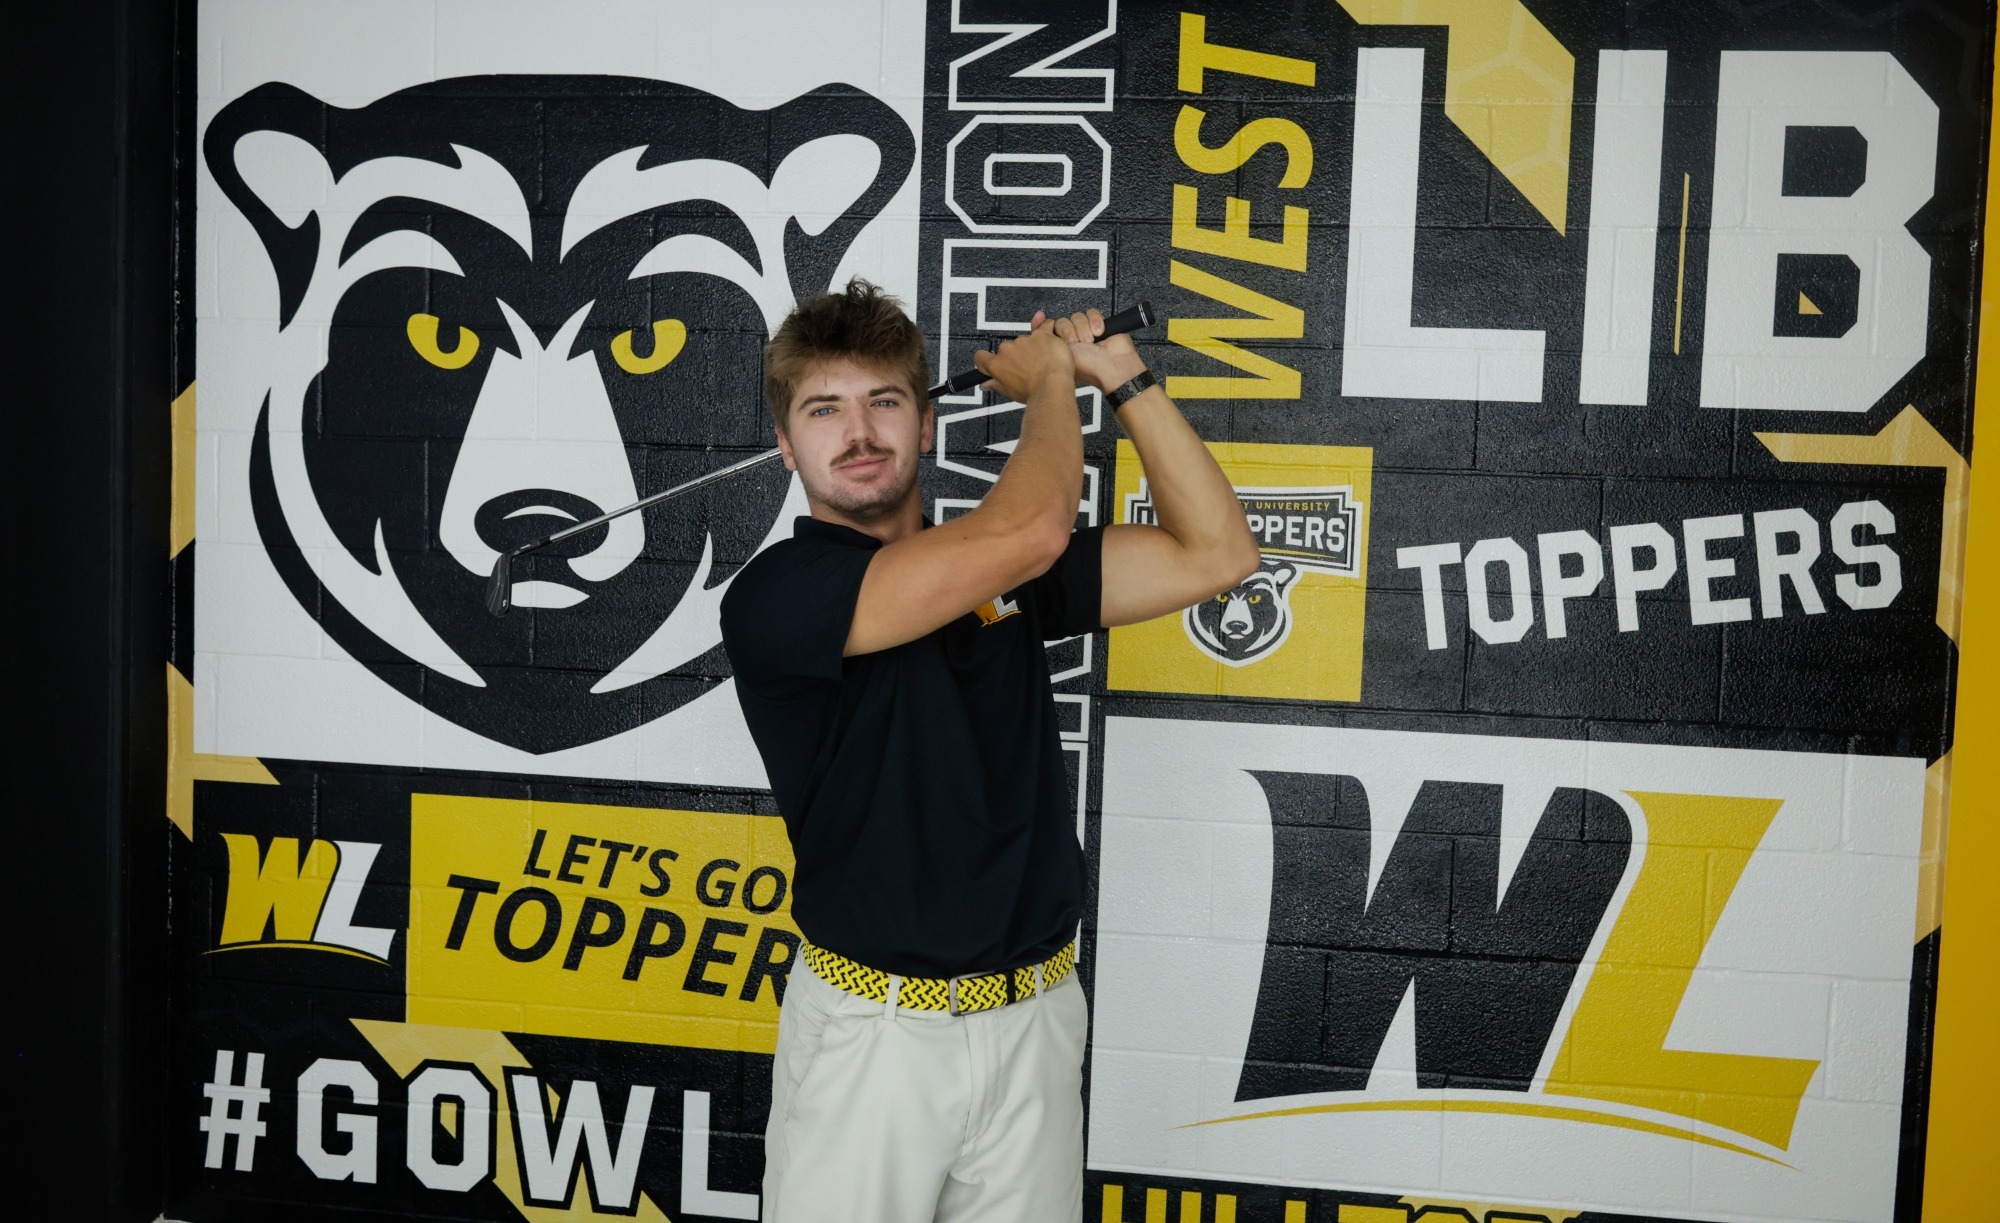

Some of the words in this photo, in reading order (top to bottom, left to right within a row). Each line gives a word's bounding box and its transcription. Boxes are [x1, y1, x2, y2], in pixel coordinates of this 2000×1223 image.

[1165, 11, 1316, 399] WEST
[1341, 47, 1940, 412] LIB
[1255, 501, 1330, 512] UNIVERSITY
[1396, 499, 1902, 650] TOPPERS
[219, 833, 396, 961] WL
[522, 829, 679, 898] LET'S
[695, 858, 788, 915] GO
[1233, 769, 1821, 1152] WL
[200, 1049, 760, 1222] #GOWL
